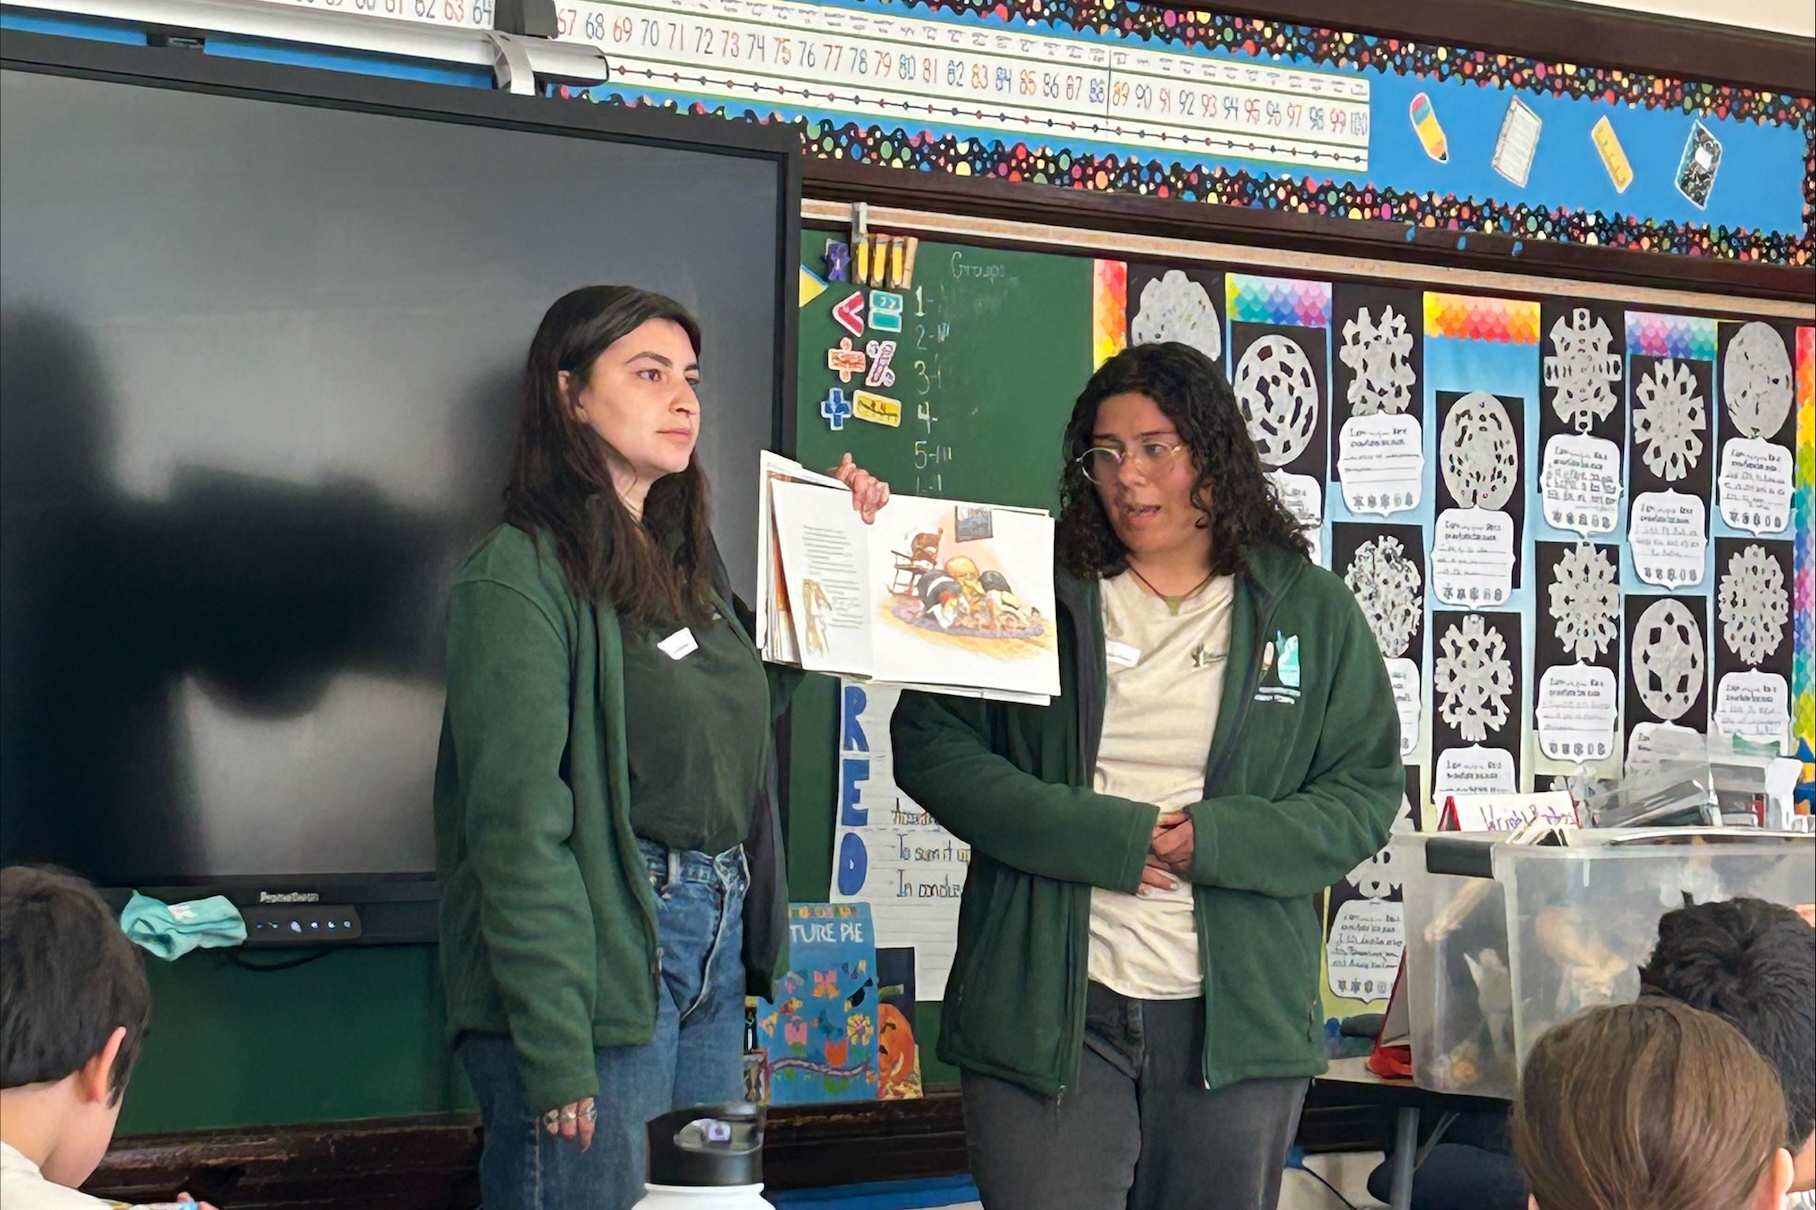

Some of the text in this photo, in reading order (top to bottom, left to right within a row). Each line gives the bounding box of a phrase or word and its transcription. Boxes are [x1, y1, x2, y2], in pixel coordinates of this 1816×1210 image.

[415, 0, 435, 18] 62
[445, 0, 464, 22] 63
[473, 0, 491, 25] 64
[558, 8, 577, 35] 67
[586, 13, 605, 40] 68
[613, 16, 633, 43] 69
[641, 19, 660, 46] 70
[668, 23, 684, 50] 71
[695, 26, 713, 54] 72
[721, 30, 739, 57] 73
[747, 33, 765, 62] 74
[773, 37, 791, 64] 75
[798, 41, 815, 67] 76
[823, 45, 843, 71] 77
[850, 48, 868, 74] 78
[874, 50, 892, 77] 79
[899, 54, 916, 80] 80
[923, 58, 937, 84] 81
[947, 60, 964, 87] 82
[971, 63, 988, 89] 83
[996, 67, 1012, 94] 84
[1020, 69, 1036, 95] 85
[1043, 73, 1059, 98] 86
[1066, 75, 1082, 100] 87
[1090, 78, 1105, 103] 88
[1113, 81, 1129, 106] 89
[1135, 84, 1152, 109] 90
[1160, 88, 1171, 113] 91
[1179, 90, 1195, 115] 92
[1201, 94, 1217, 117] 93
[1224, 96, 1239, 120] 94
[1244, 98, 1260, 125] 95
[1266, 100, 1281, 126] 96
[1287, 102, 1303, 127] 97
[1310, 106, 1324, 130] 98
[1330, 107, 1346, 134] 99
[1351, 112, 1368, 136] 100
[897, 833, 911, 860] To
[896, 869, 913, 897] In
[840, 922, 863, 943] PIE
